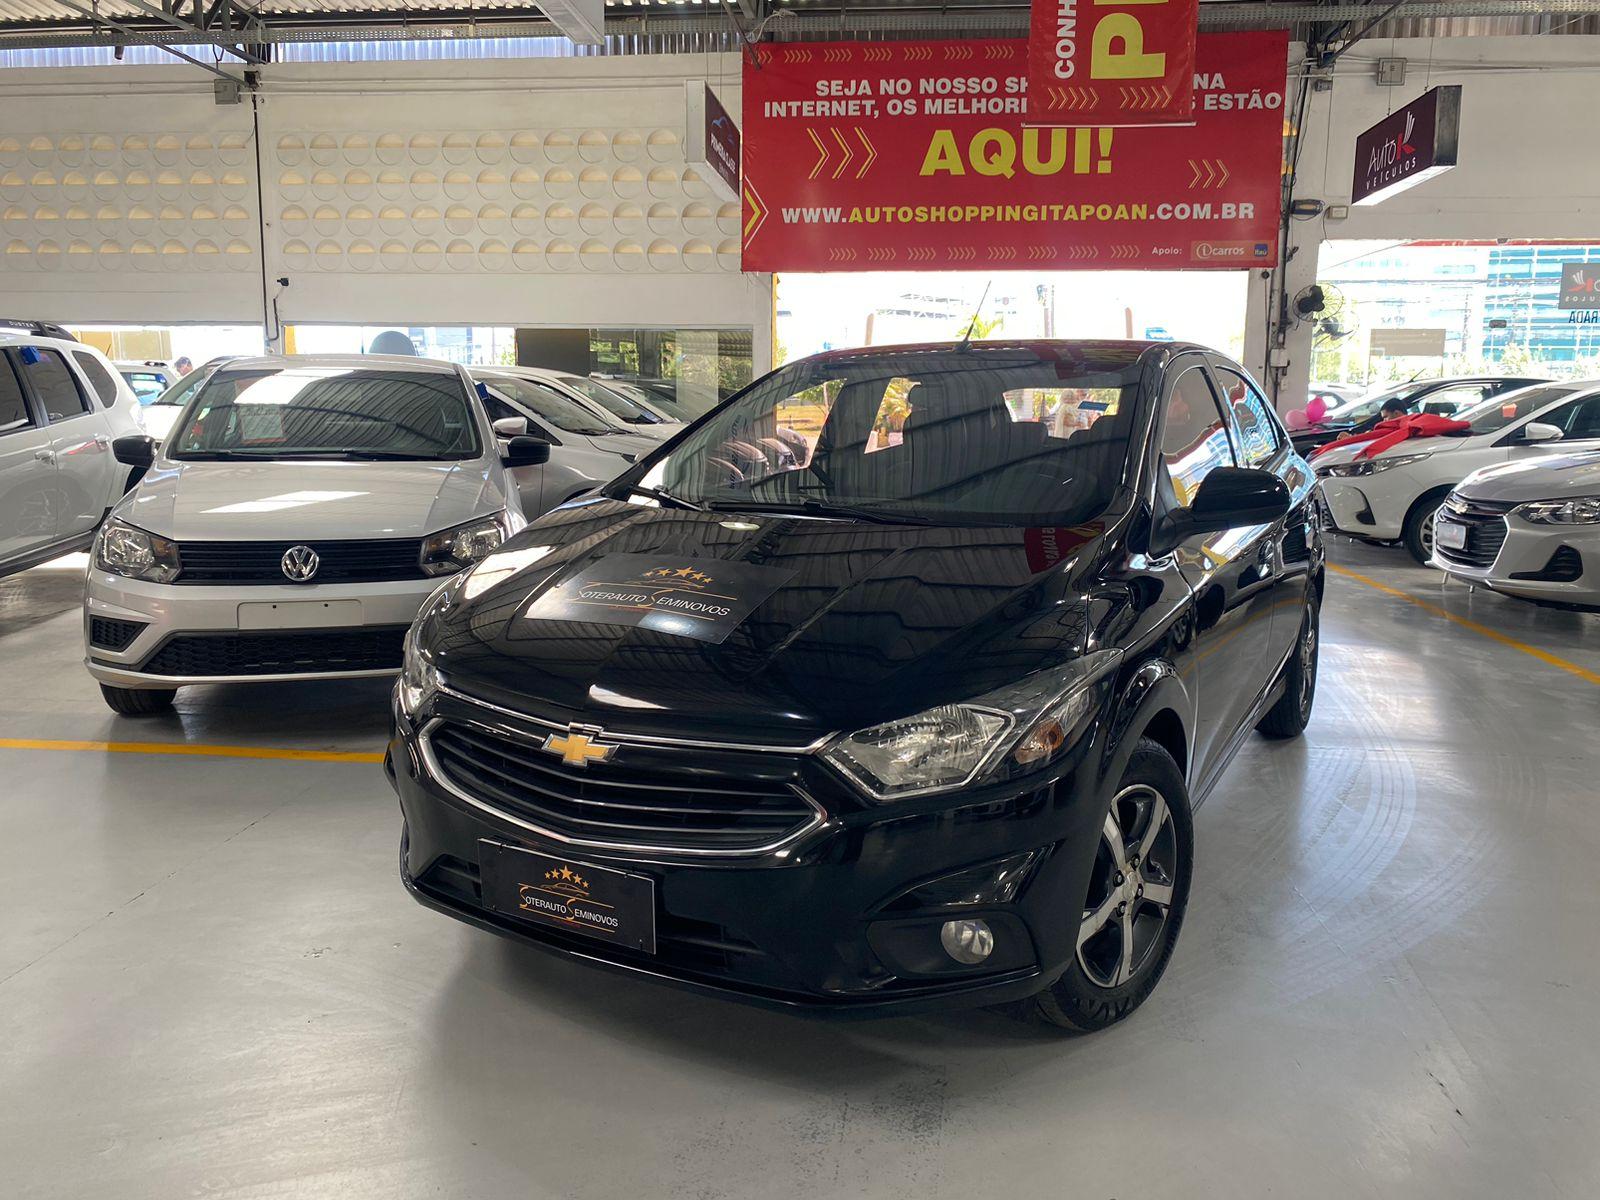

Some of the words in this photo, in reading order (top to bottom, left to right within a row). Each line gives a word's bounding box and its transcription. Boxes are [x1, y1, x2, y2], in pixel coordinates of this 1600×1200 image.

[816, 79, 872, 97] SEJA
[880, 78, 912, 96] NO
[919, 77, 998, 95] NOSSO
[1193, 73, 1226, 90] NA
[764, 99, 879, 119] INTERNET,
[886, 98, 917, 116] OS
[1204, 88, 1282, 111] ESTÃO
[919, 127, 1114, 180] AQUI!
[781, 203, 1254, 223] WWW.AUTOSHOPPINGITAPOAN.COM.BR
[1152, 246, 1182, 256] Apoio:
[518, 886, 567, 915] SOTERAUTO
[566, 897, 619, 928] SEMINOVOS
